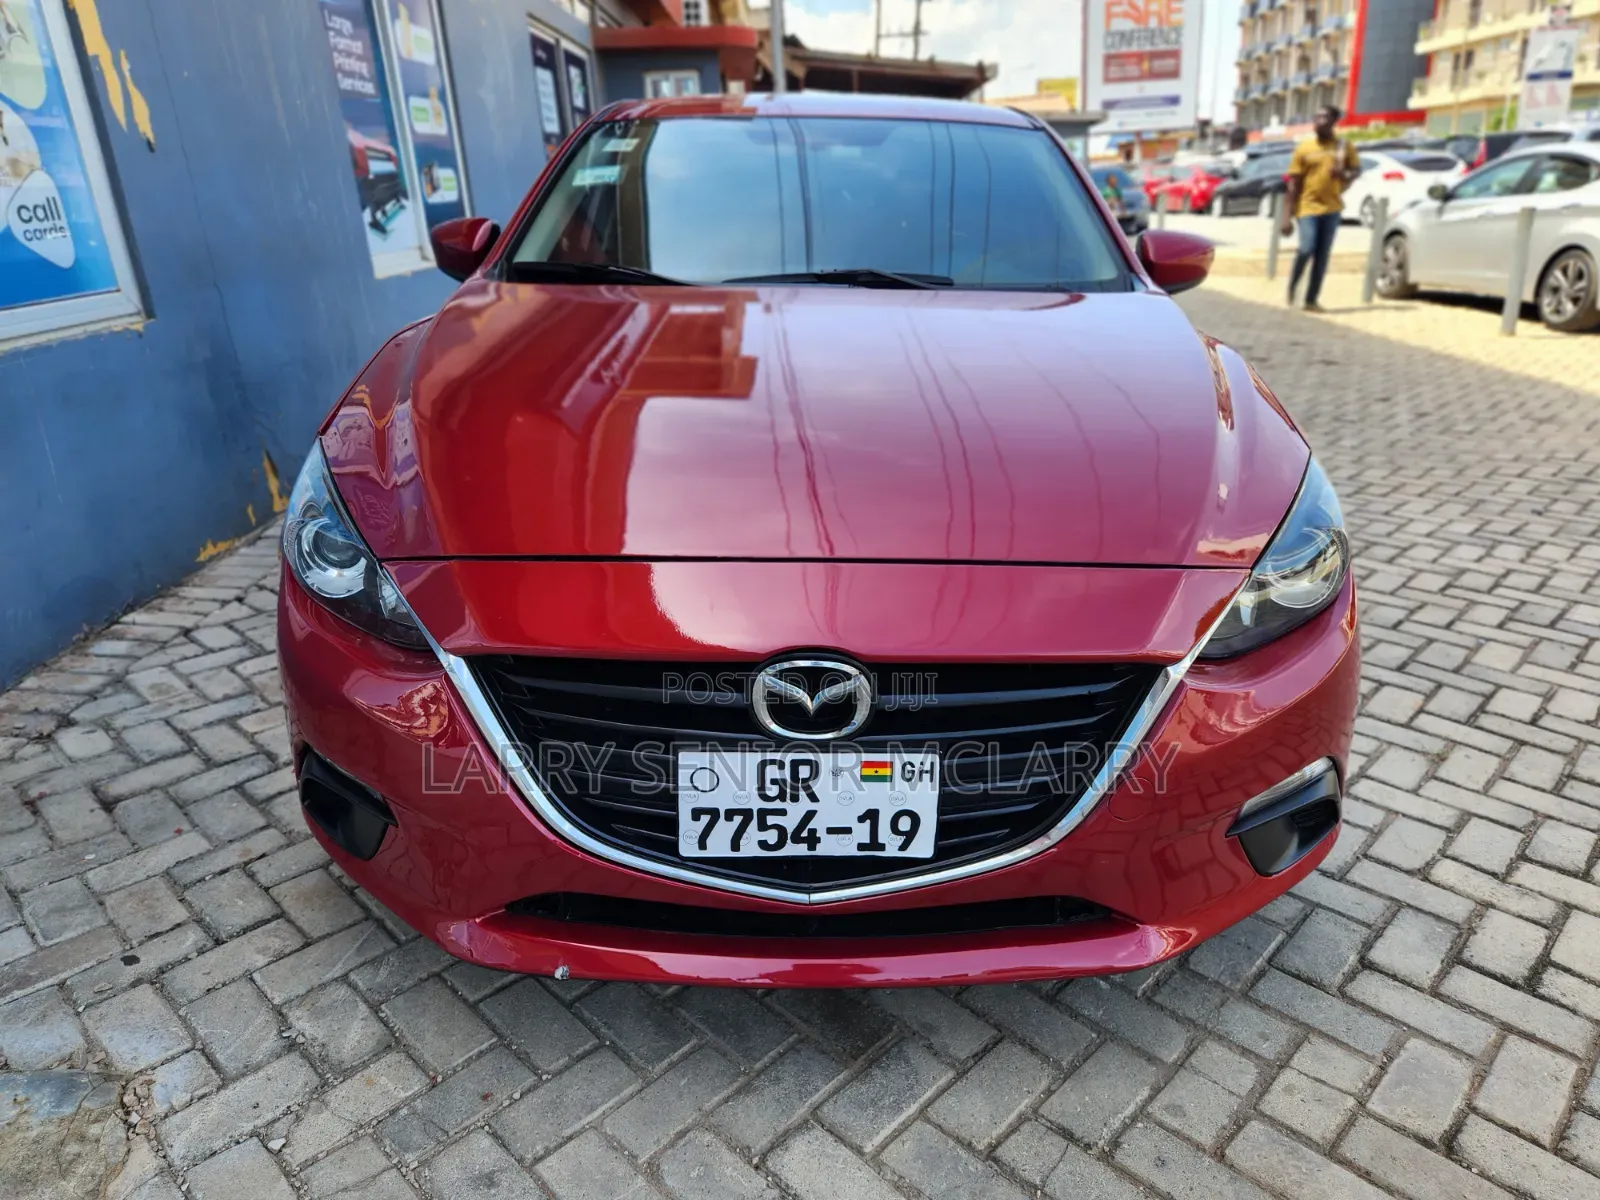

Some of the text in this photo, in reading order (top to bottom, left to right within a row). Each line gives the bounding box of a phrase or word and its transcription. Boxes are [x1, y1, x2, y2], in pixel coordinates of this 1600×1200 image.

[328, 30, 363, 56] Format
[332, 50, 370, 79] Printing
[16, 196, 61, 224] call
[756, 759, 821, 803] GR
[901, 761, 935, 783] GH
[690, 807, 922, 852] 7754-19
